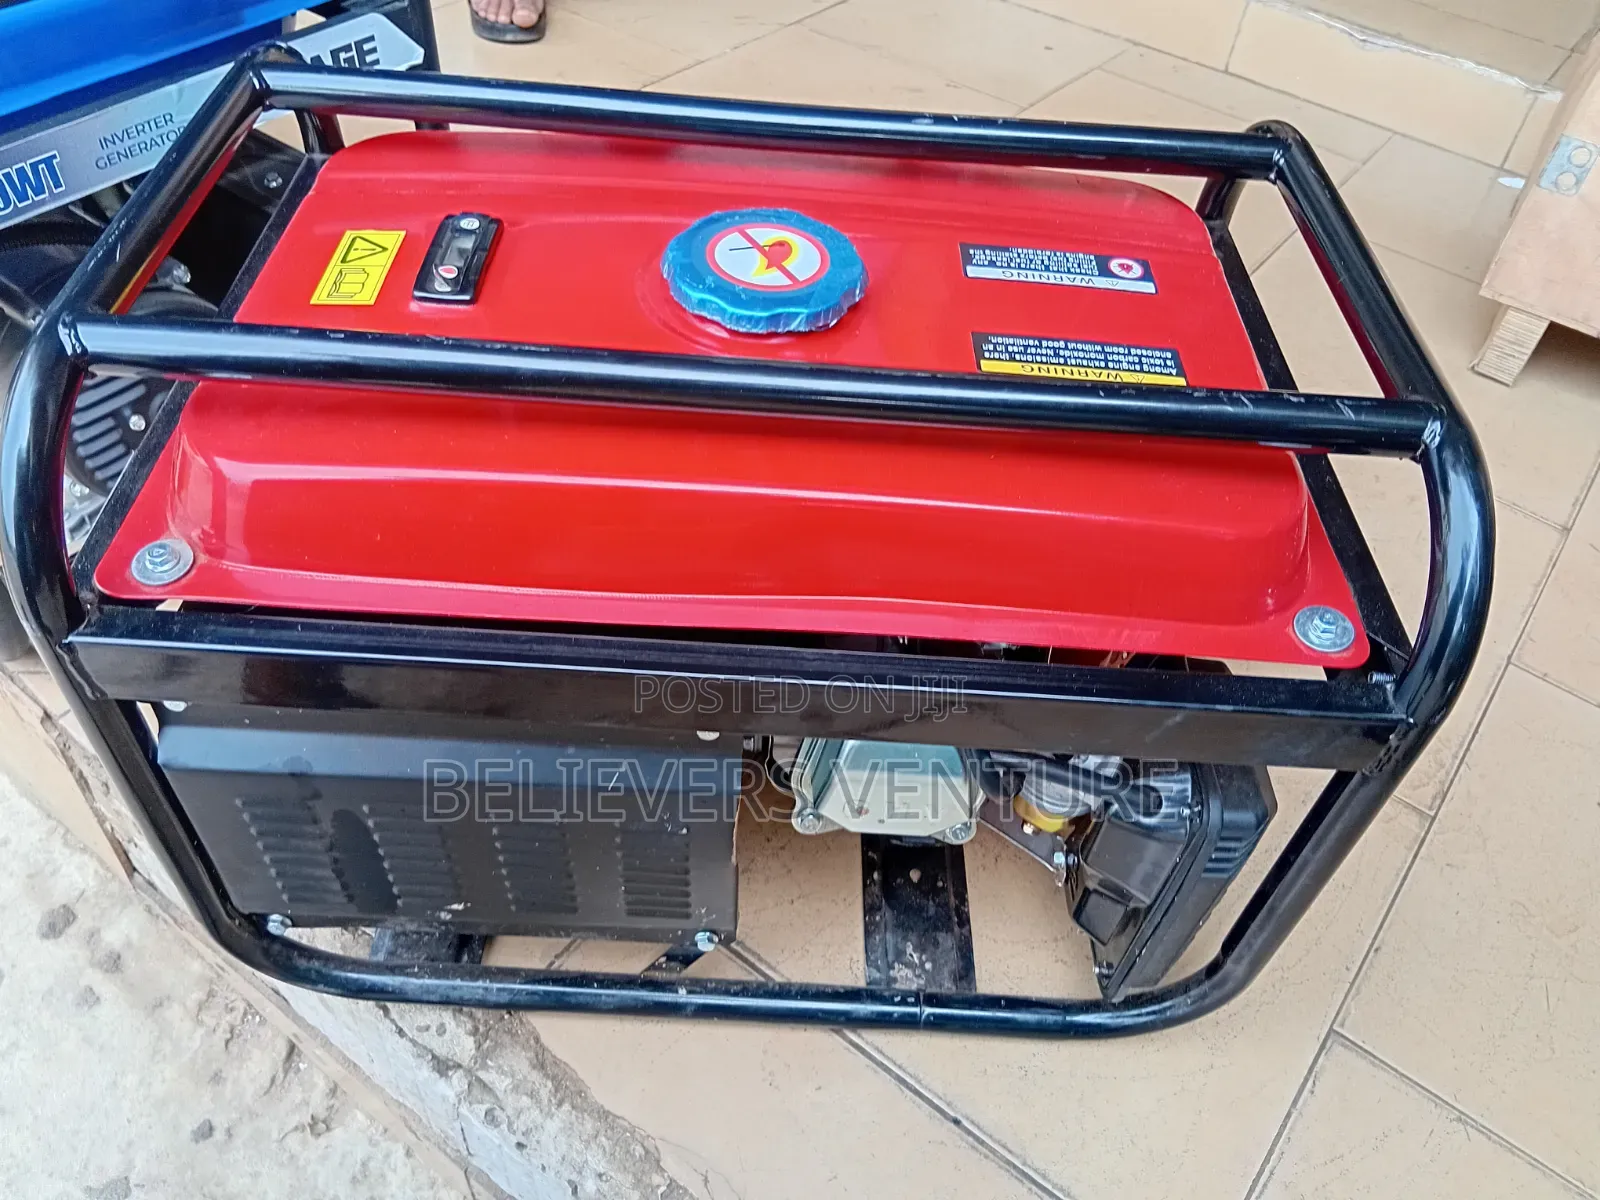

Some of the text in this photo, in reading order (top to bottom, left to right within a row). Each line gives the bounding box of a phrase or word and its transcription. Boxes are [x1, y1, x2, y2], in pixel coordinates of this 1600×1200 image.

[98, 112, 175, 150] INVERTER
[1001, 270, 1095, 285] WARNING
[1041, 338, 1065, 348] good
[1066, 342, 1102, 352] without
[1025, 346, 1054, 356] Never
[1103, 345, 1128, 354] room
[1129, 348, 1172, 358] enclosed
[983, 351, 1009, 360] there
[1106, 353, 1139, 363] carbon
[1066, 357, 1106, 368] exhaust
[1107, 361, 1141, 371] engine
[1140, 356, 1164, 366] toxic
[1020, 364, 1123, 381] WARNING
[1142, 363, 1177, 375] Among
